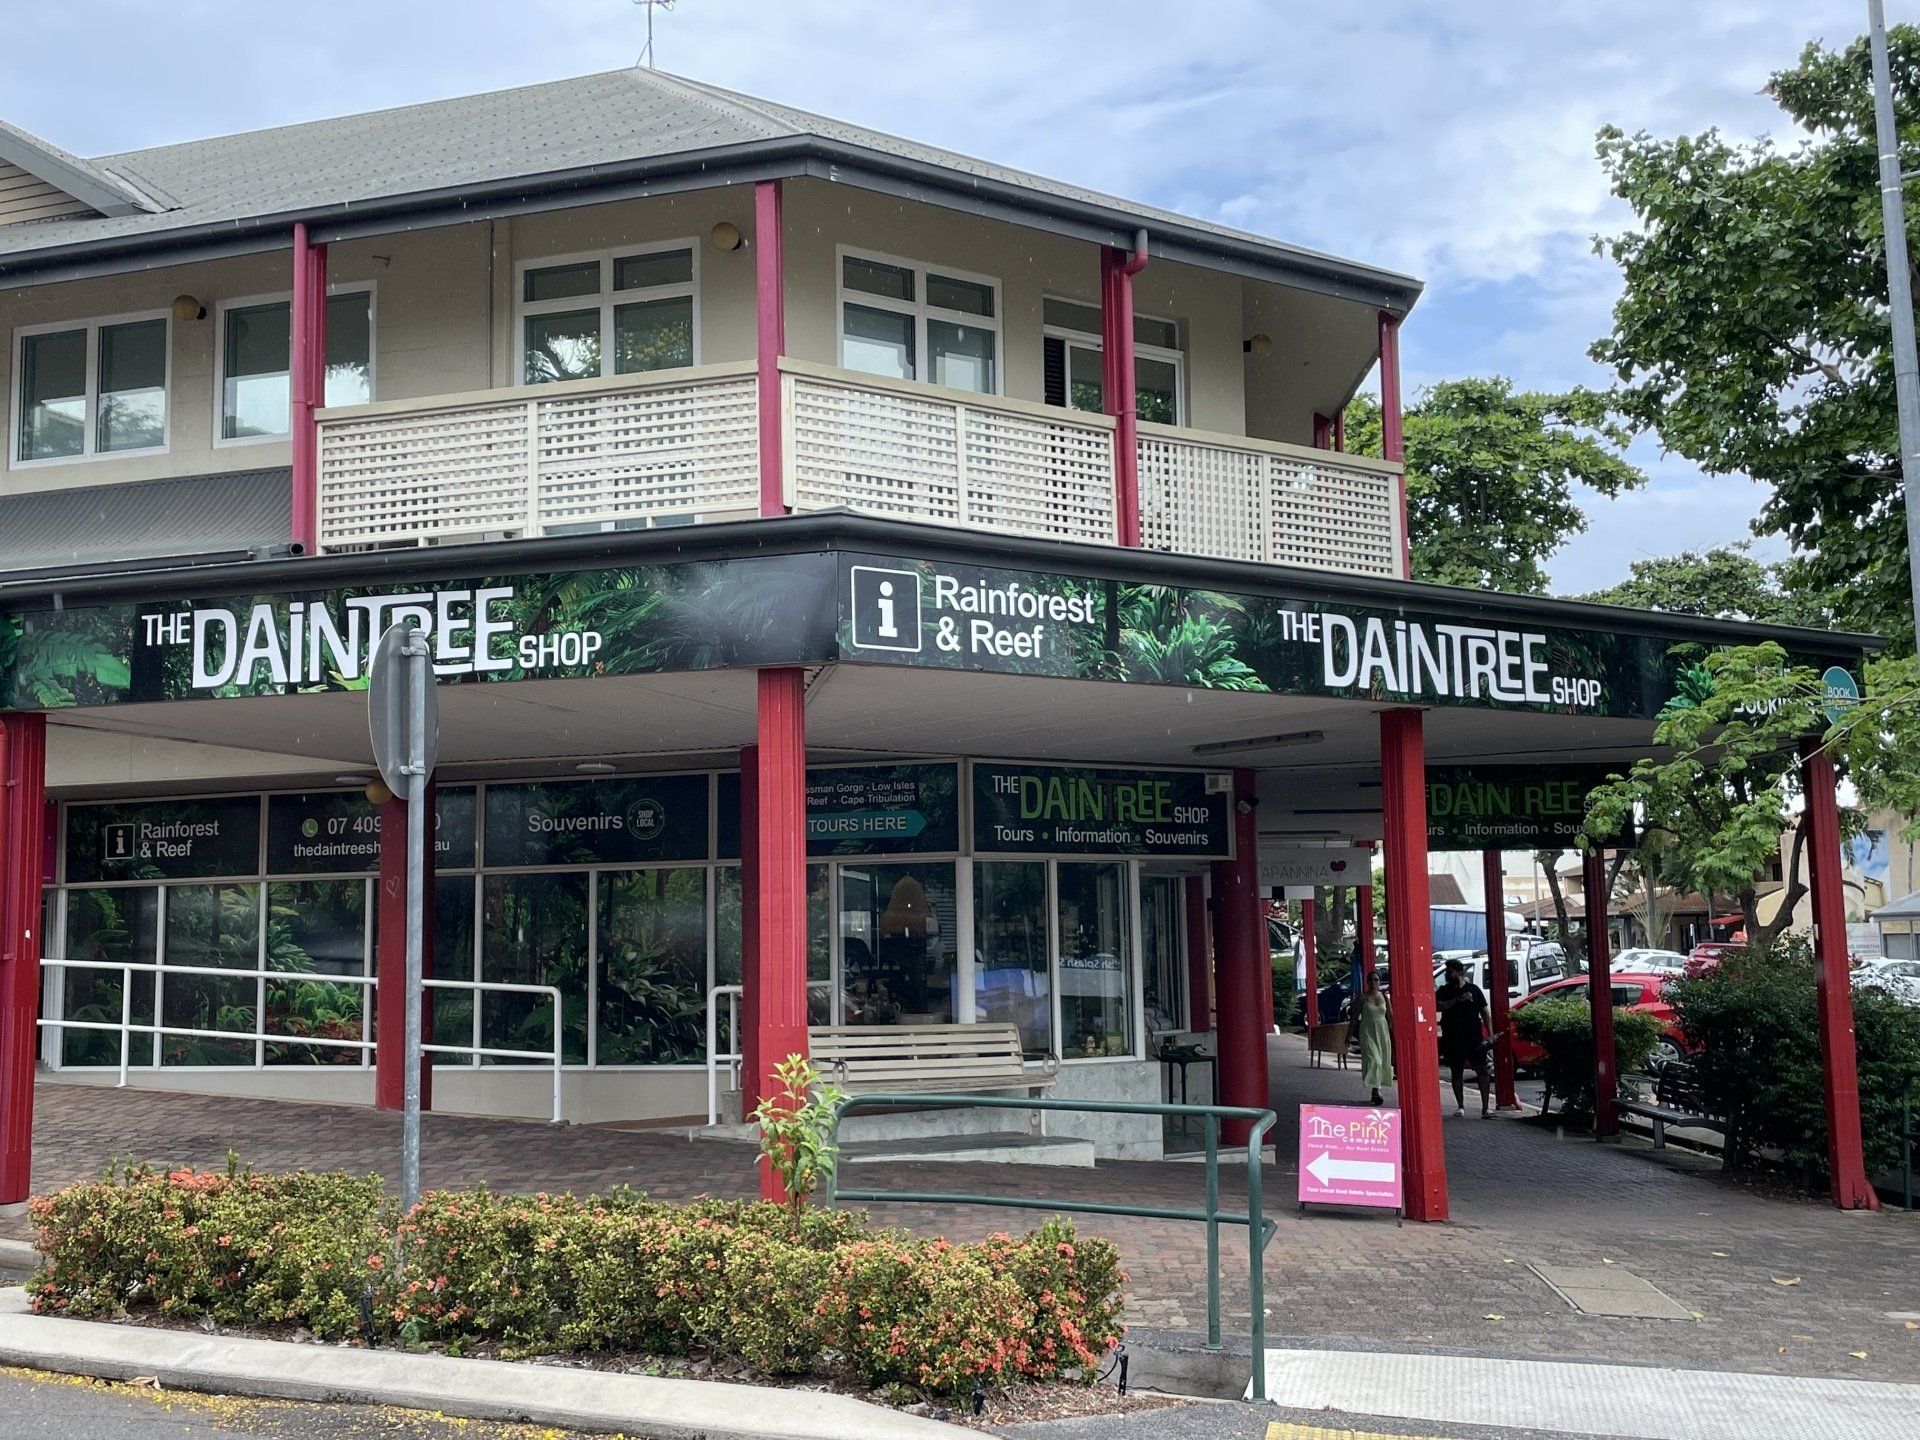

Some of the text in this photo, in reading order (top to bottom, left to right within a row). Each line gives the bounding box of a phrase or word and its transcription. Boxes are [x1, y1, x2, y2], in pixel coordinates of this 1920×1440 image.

[935, 574, 1095, 625] Rainforest
[141, 612, 190, 646] THE
[519, 631, 602, 669] SHOP
[936, 617, 1043, 659] & Reef
[1277, 609, 1321, 643] THE
[1552, 676, 1601, 707] SHOP
[1827, 687, 1851, 698] BOOK
[805, 781, 915, 794] ssman Gorge Low Isles
[807, 793, 915, 805] Reef Cape Tribulation
[992, 776, 1018, 793] THE
[1174, 806, 1208, 824] SHOP
[528, 812, 623, 832] Souvenirs
[636, 818, 655, 828] LOCAL
[638, 810, 654, 819] SHOP
[140, 820, 219, 839] Rainforest
[328, 816, 382, 835] 07 409
[808, 816, 907, 833] TOURS HERE
[1465, 823, 1538, 835] Information
[994, 826, 1208, 845] Tours Information Souvenirs
[140, 840, 193, 858] & Reef
[1308, 1116, 1389, 1140] The Pink
[1343, 1137, 1388, 1145] Company
